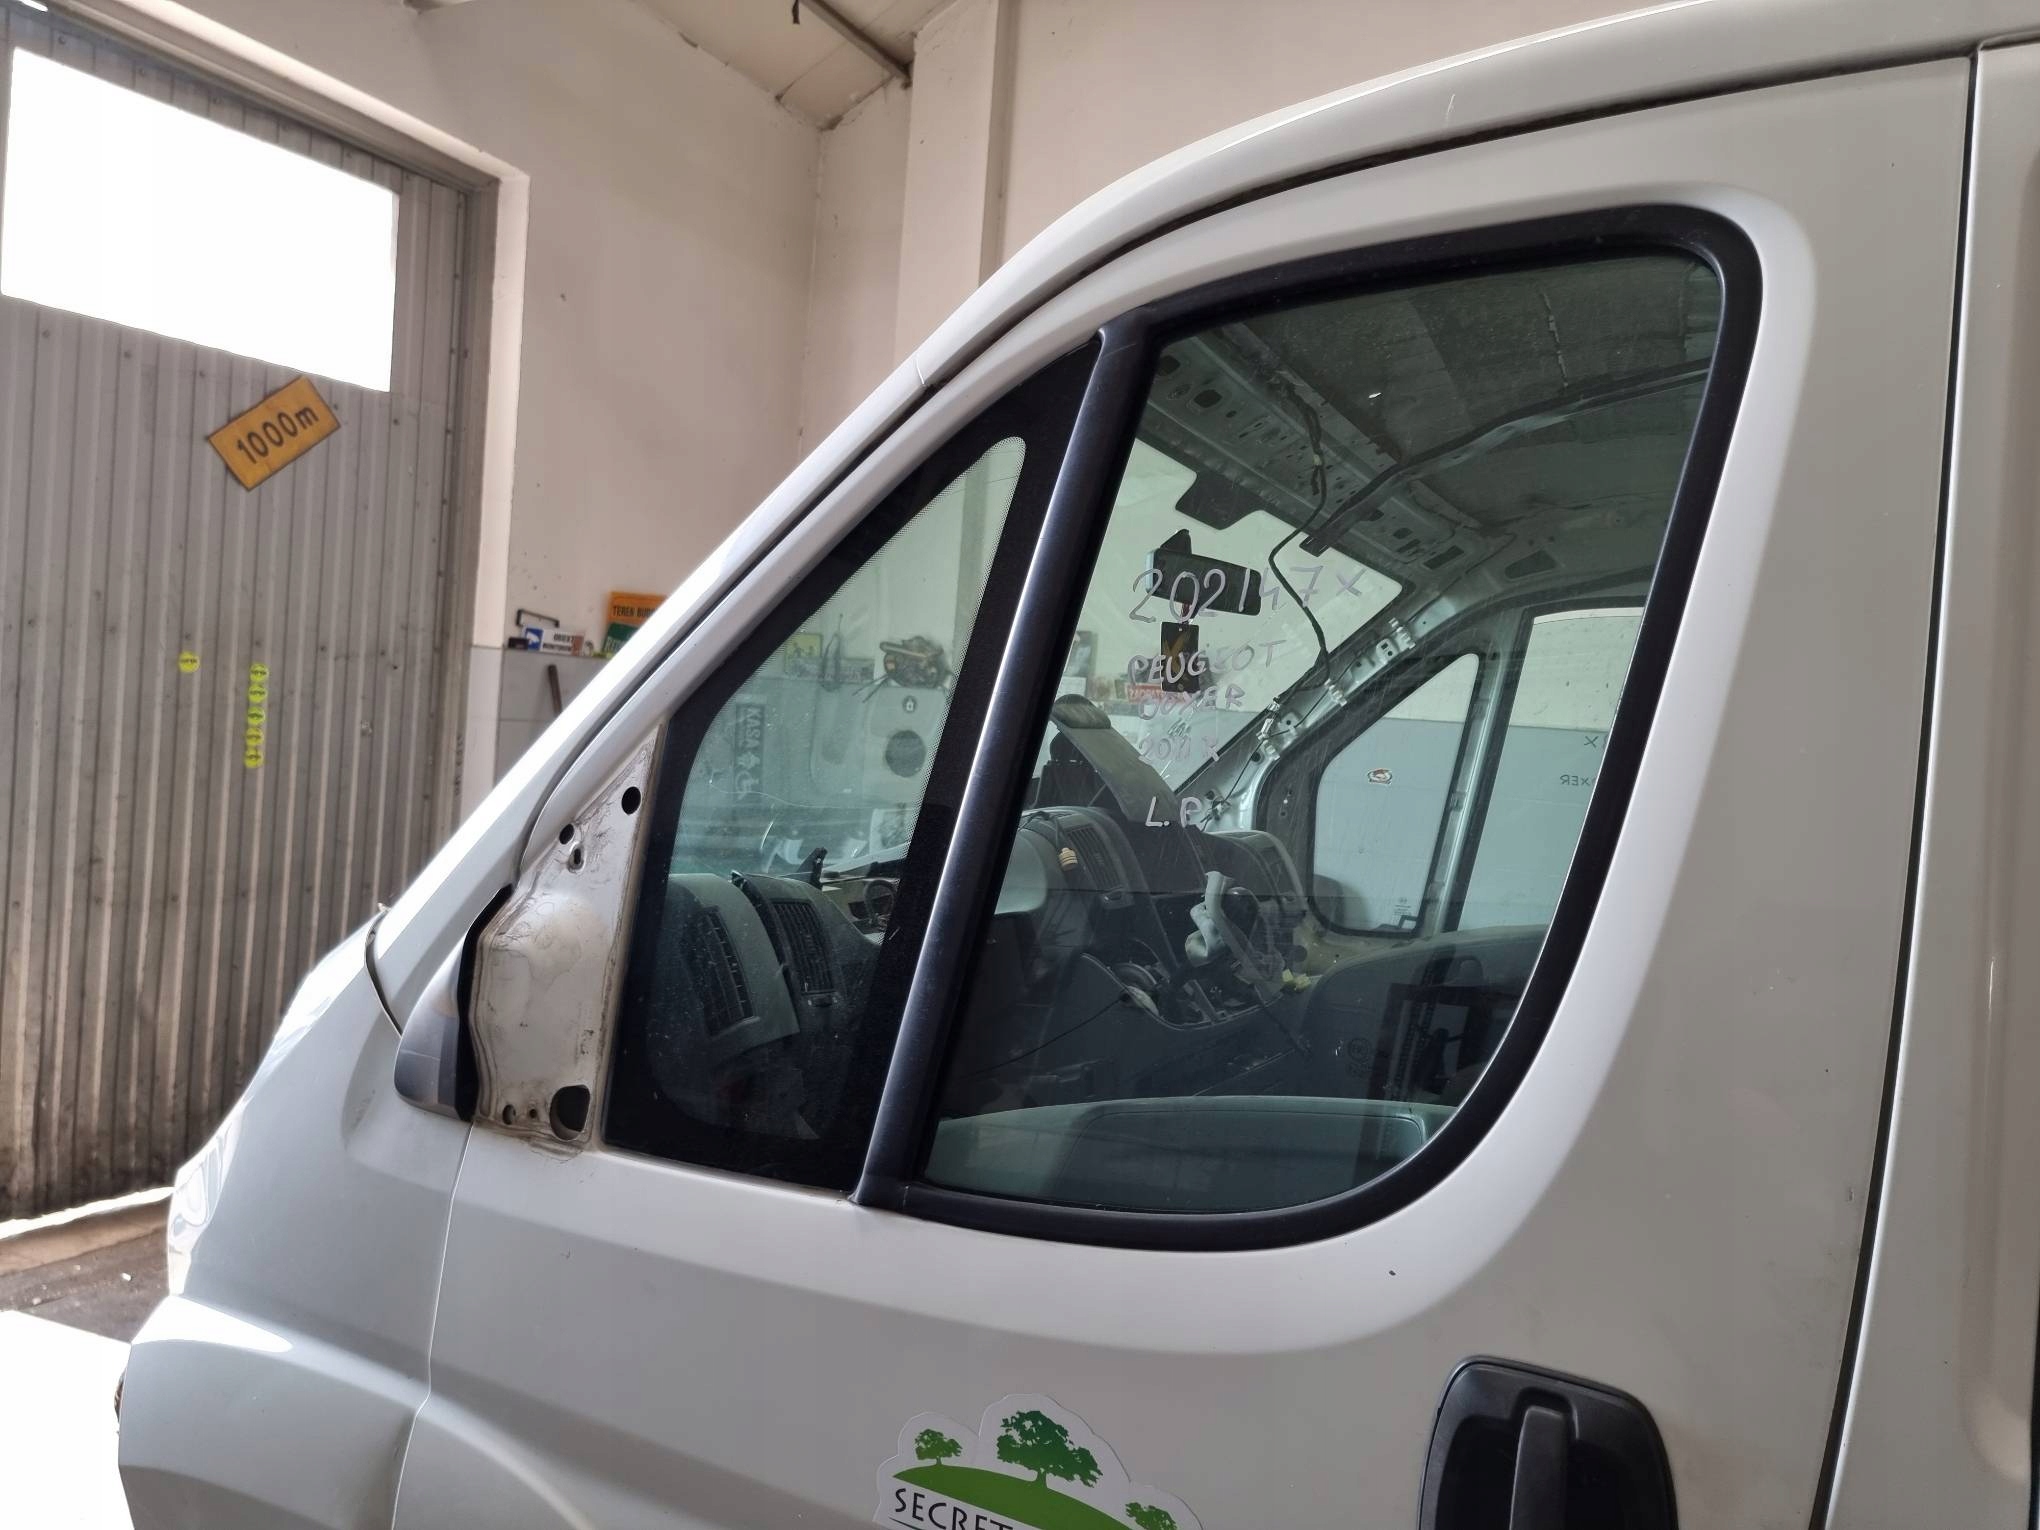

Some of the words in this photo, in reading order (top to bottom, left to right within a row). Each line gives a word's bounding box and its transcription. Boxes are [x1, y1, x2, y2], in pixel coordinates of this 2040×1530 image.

[236, 407, 319, 464] 1000m
[1128, 640, 1286, 684] PEUGEOT
[745, 707, 760, 748] KASA
